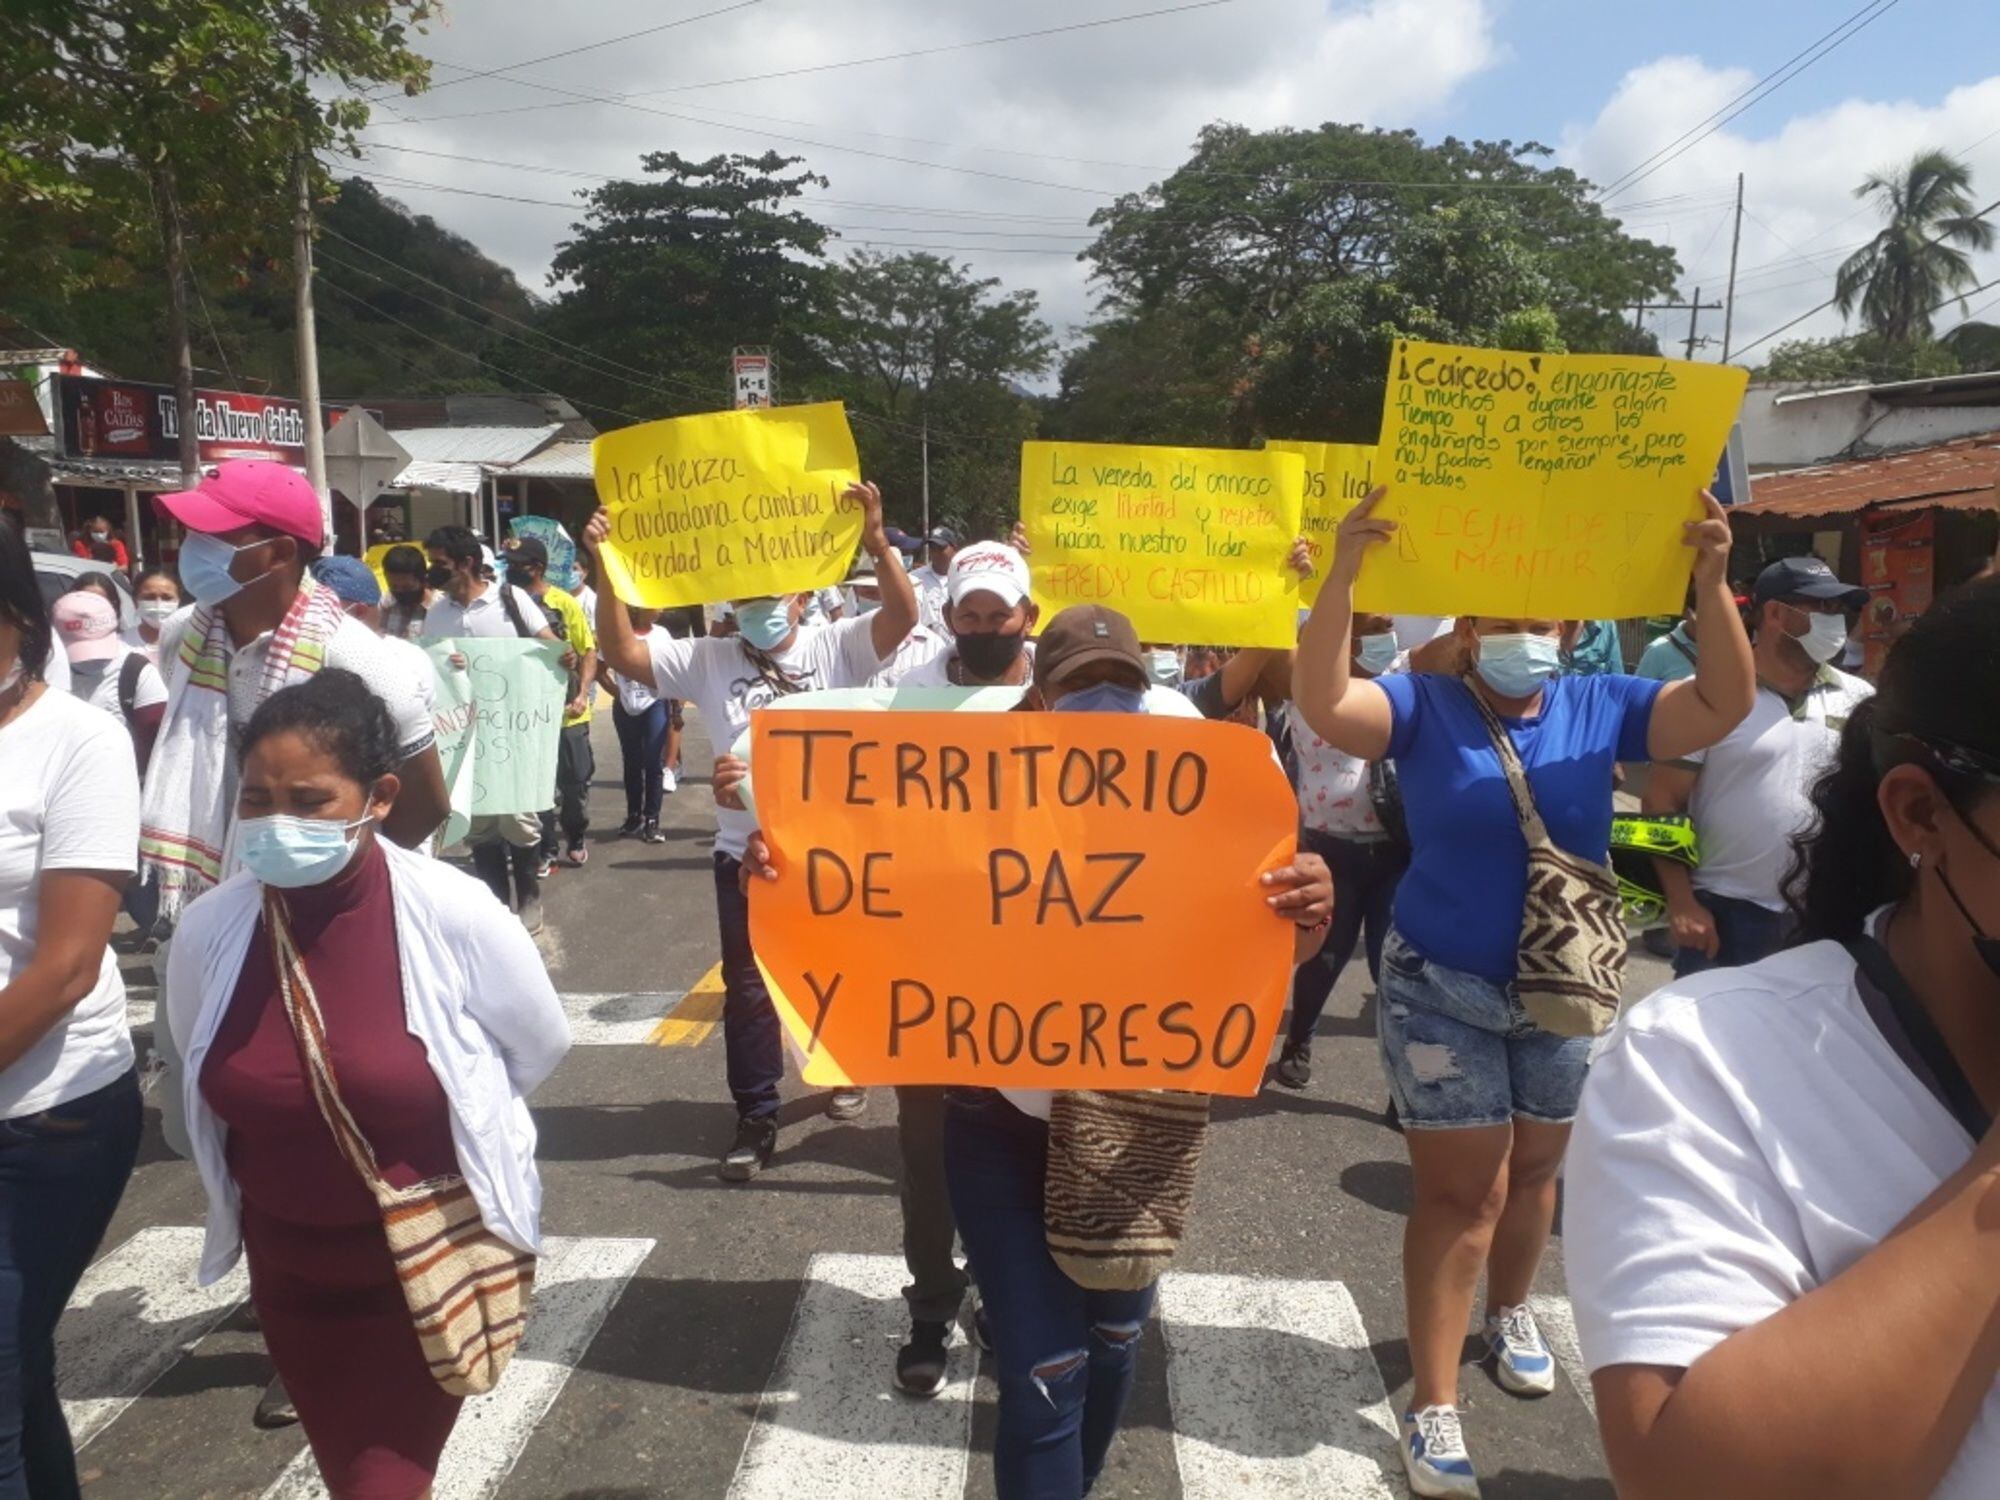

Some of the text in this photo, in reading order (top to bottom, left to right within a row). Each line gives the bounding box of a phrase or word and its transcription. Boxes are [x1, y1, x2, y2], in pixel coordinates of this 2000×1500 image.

[1424, 387, 1495, 411] muchos
[1527, 390, 1598, 414] durante
[216, 401, 263, 444] Nuevo
[1503, 414, 1521, 433] a
[1533, 411, 1584, 432] otros
[1616, 411, 1641, 432] los
[1517, 438, 1549, 464] por
[1644, 433, 1687, 457] pero
[648, 455, 745, 493] fuerza
[1052, 451, 1078, 485] La
[1093, 461, 1157, 489] vereda
[1170, 463, 1197, 491] del
[1052, 496, 1097, 527] exige
[1117, 492, 1177, 520] libertad
[716, 544, 733, 567] a
[1055, 522, 1105, 549] hacia
[1119, 527, 1187, 554] nuestro
[1046, 563, 1263, 604] FREDY CASTILLO
[769, 730, 1208, 816] TERRITORIO
[806, 848, 1145, 927] DE PAZ
[802, 972, 1257, 1073] Y PROGRESO
